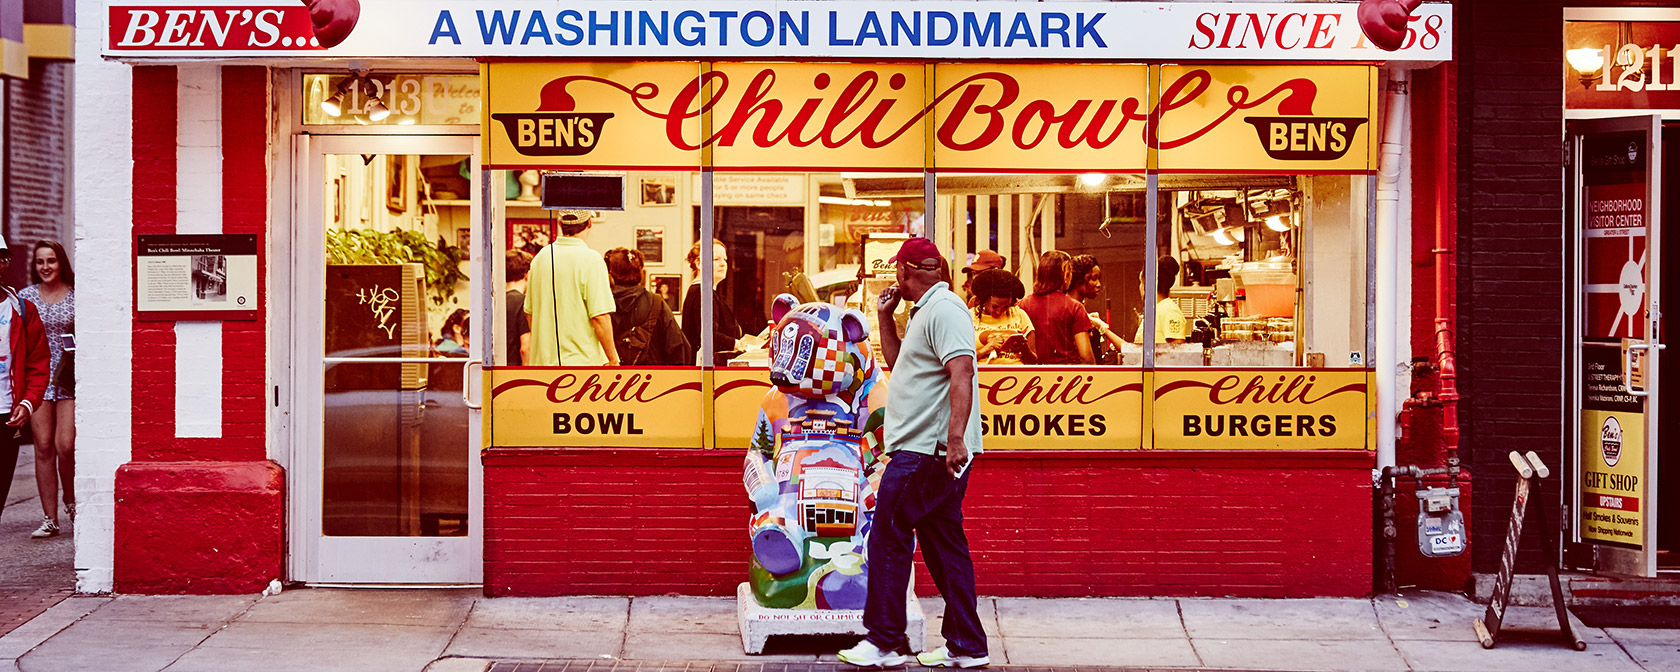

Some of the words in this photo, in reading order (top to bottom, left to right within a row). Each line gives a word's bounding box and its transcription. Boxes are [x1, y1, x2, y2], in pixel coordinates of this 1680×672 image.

[428, 10, 462, 45] A
[475, 10, 809, 46] WASHINGTON
[828, 11, 1108, 48] LANDMARK
[1188, 12, 1342, 49] SINCE
[1351, 13, 1443, 50] 58
[1596, 43, 1680, 92] 1211
[459, 103, 475, 114] to
[650, 68, 928, 151] Chili
[936, 69, 1213, 151] Bowl
[518, 117, 594, 147] BEN'S
[1269, 120, 1347, 152] BEN'S
[1590, 199, 1642, 212] NEIGHBORHOOD
[1590, 215, 1614, 227] VISITOR
[1615, 214, 1642, 227] CENTER
[546, 373, 658, 403] Chili
[987, 375, 1097, 405] Chili
[1209, 375, 1319, 404] Chili
[553, 413, 643, 435] BOWL
[1183, 414, 1337, 437] BURGERS
[1602, 424, 1618, 439] Ben's
[1585, 471, 1608, 489] GIFT
[1610, 473, 1638, 492] SHOP
[1599, 495, 1623, 509] UPSTAIRS
[1593, 511, 1611, 523] Smokes
[1612, 513, 1616, 523] &
[1616, 514, 1639, 526] Souvenirs
[1435, 536, 1447, 545] DC
